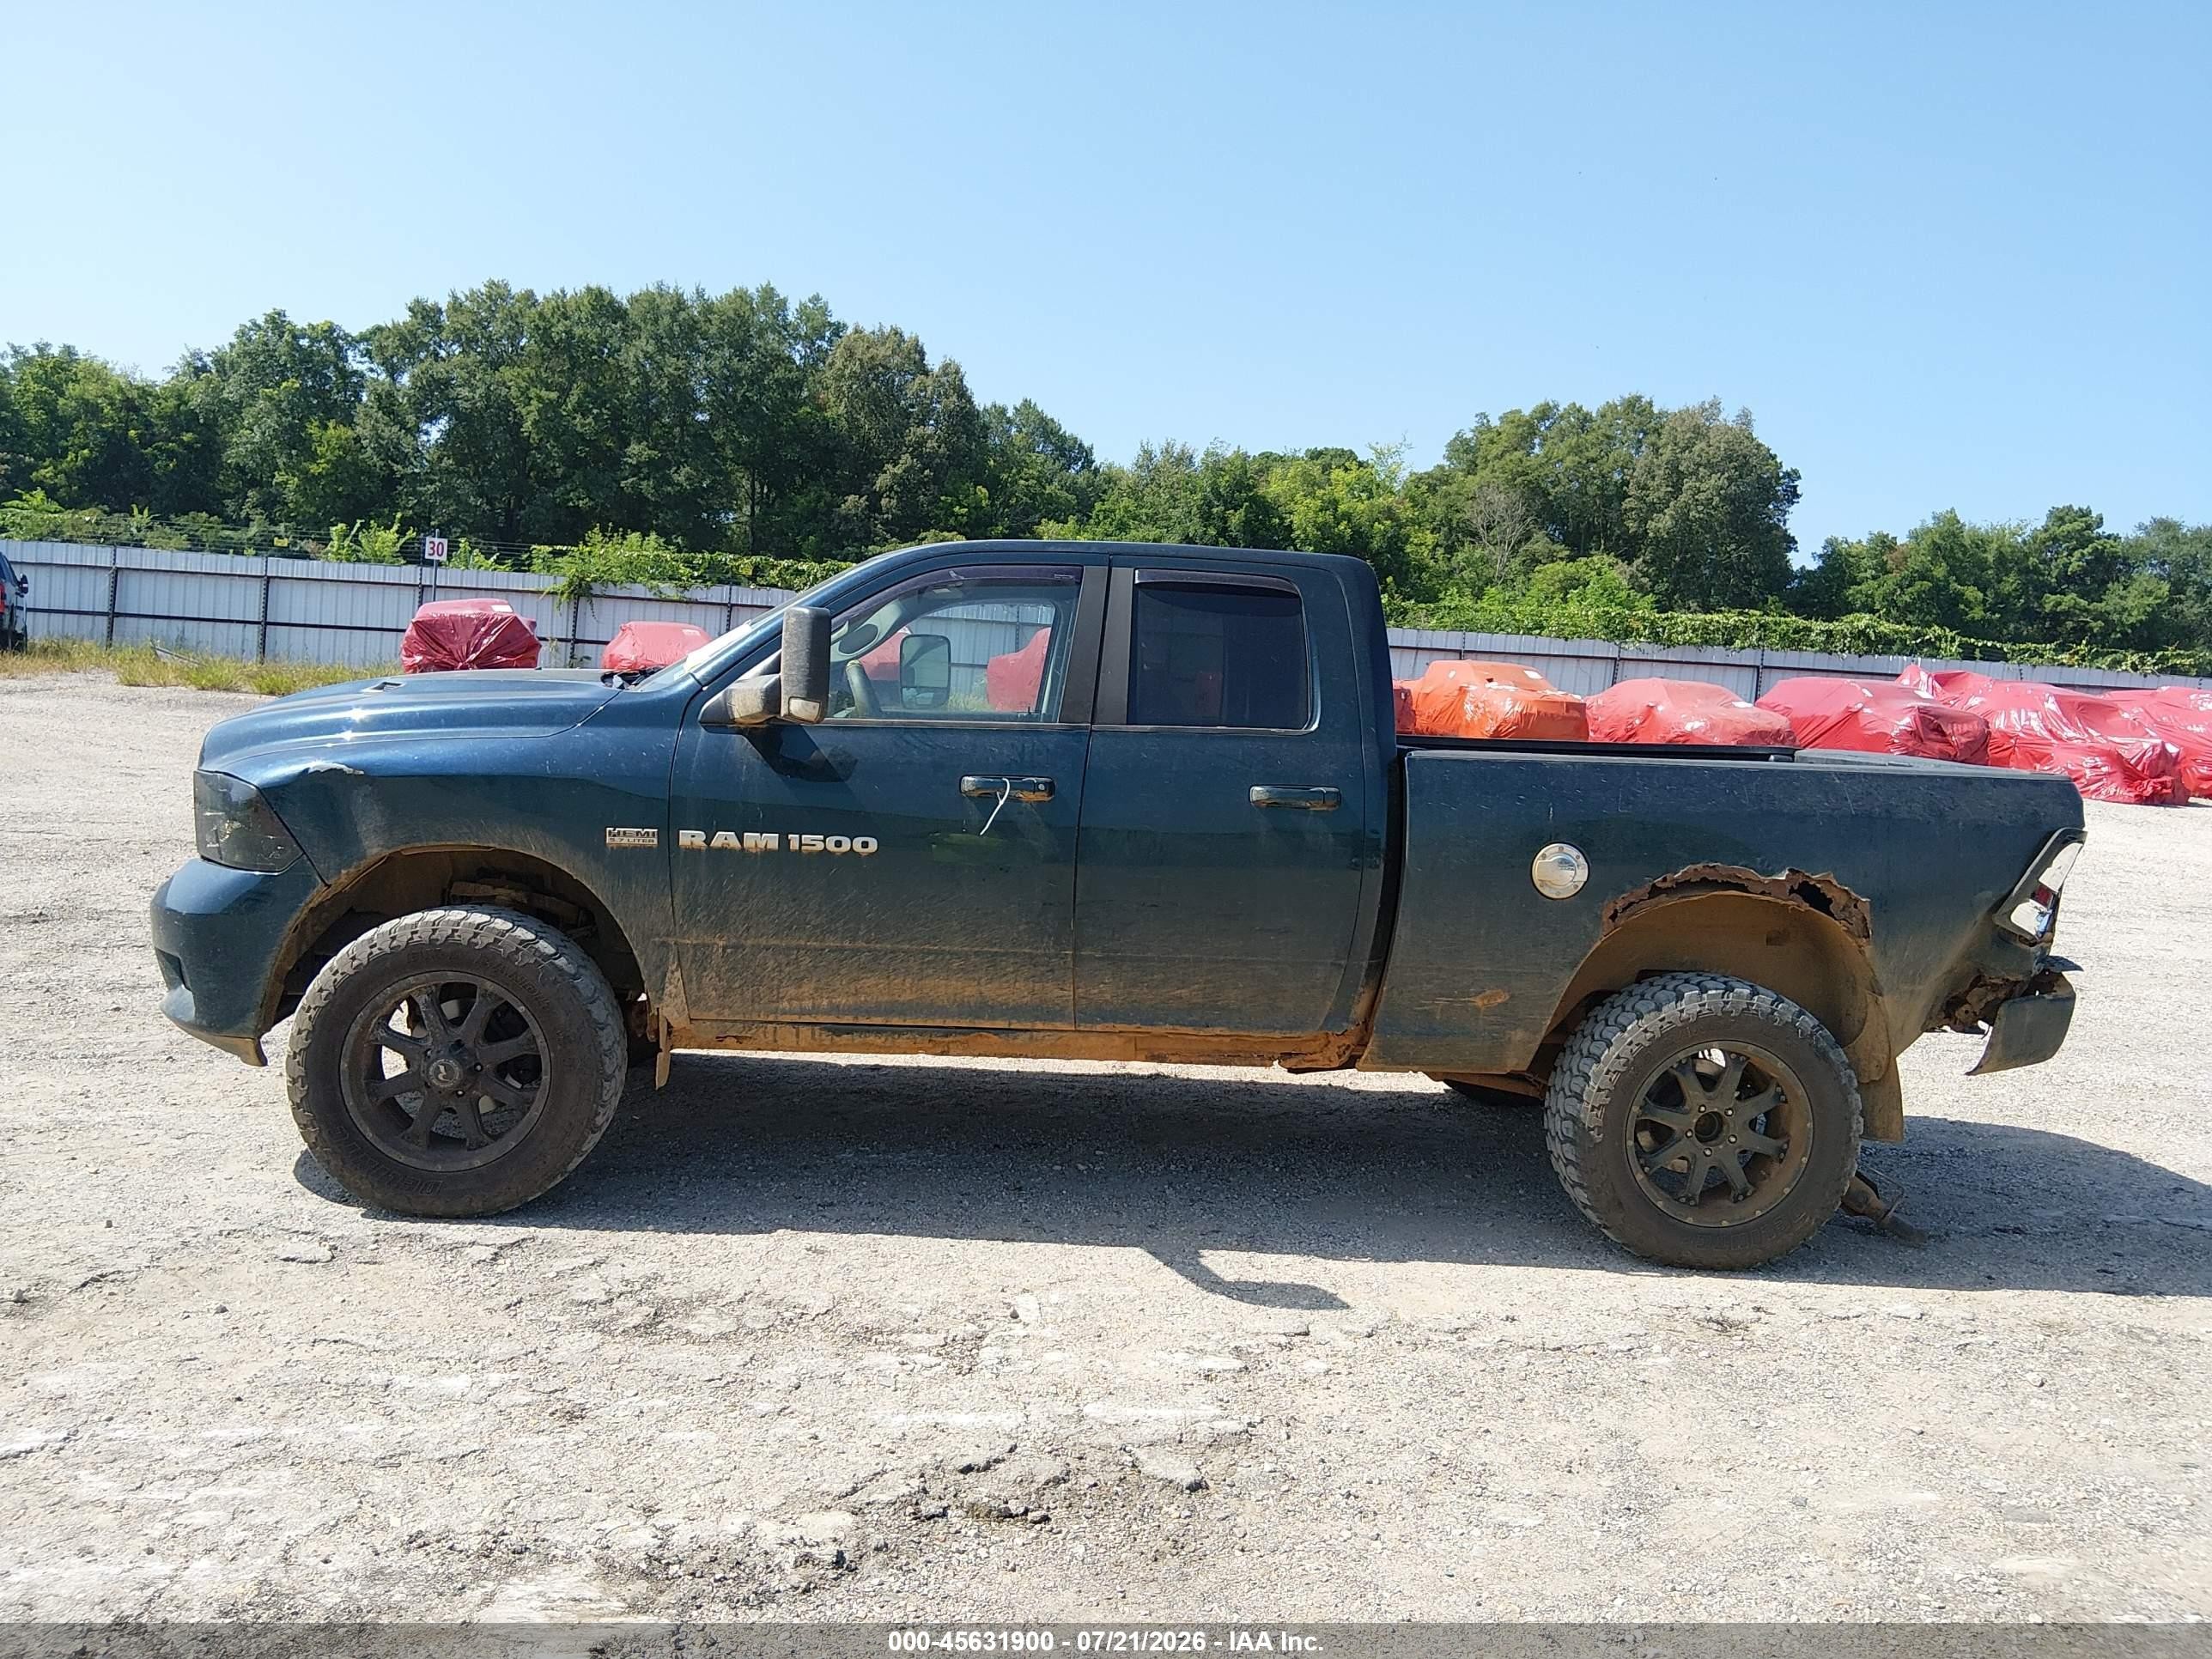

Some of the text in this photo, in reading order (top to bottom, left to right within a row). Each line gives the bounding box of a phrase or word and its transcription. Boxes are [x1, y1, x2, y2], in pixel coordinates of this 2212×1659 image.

[428, 541, 445, 556] 30
[608, 829, 656, 837] HEMI
[678, 830, 878, 853] RAM 1500
